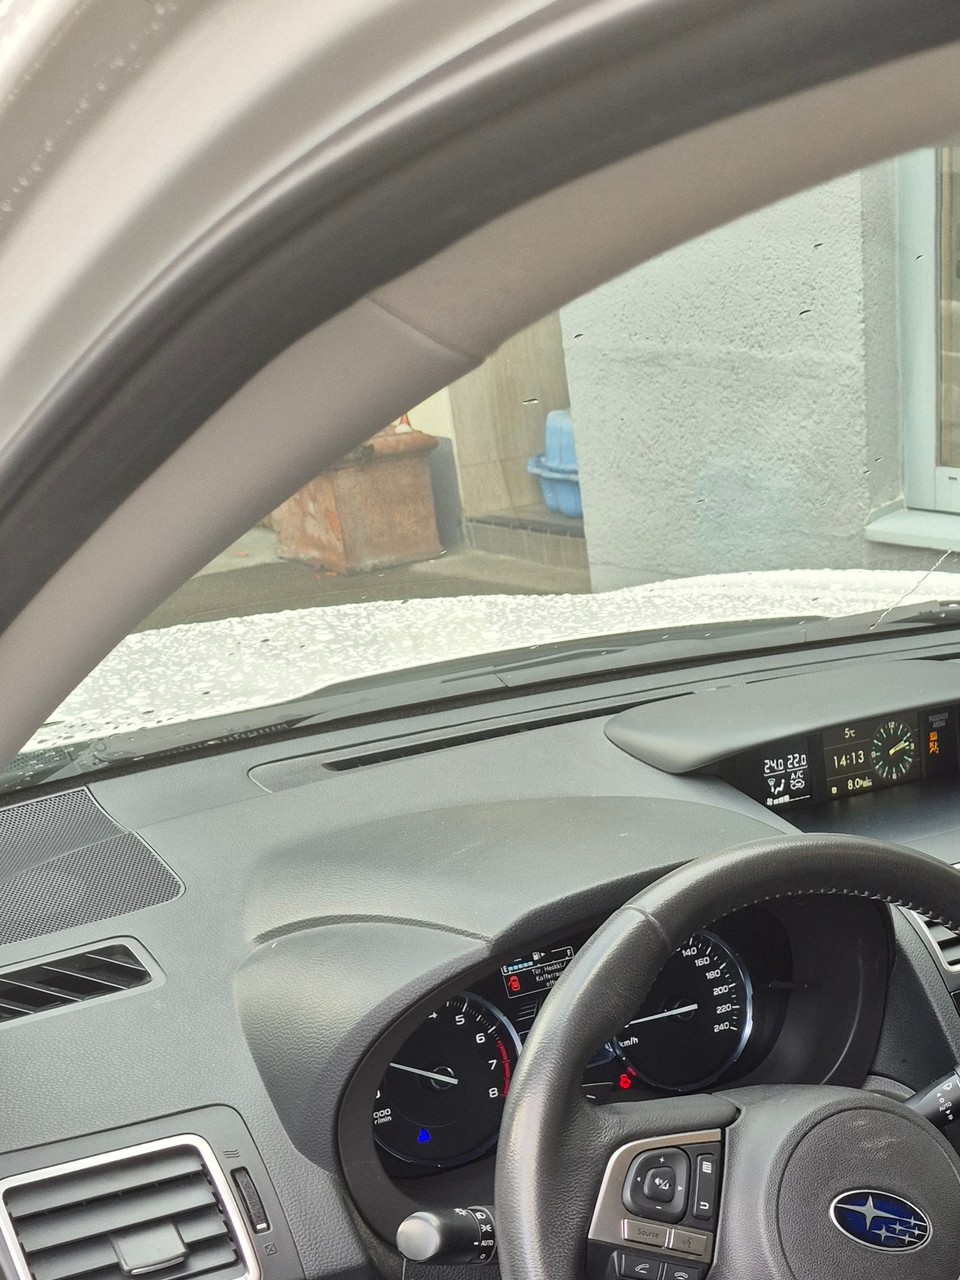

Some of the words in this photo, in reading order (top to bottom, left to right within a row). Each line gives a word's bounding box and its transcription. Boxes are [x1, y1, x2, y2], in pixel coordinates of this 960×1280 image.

[764, 759, 784, 773] 24.0
[786, 753, 807, 767] 22.0
[832, 751, 865, 770] 14:13
[790, 770, 804, 779] A/C
[847, 779, 860, 790] 8.0
[682, 946, 697, 957] 140
[695, 956, 710, 967] 160
[705, 969, 721, 980] 180
[713, 985, 729, 995] 200
[716, 1003, 732, 1014] 220
[455, 1014, 466, 1025] 5
[713, 1022, 730, 1032] 240
[475, 1033, 486, 1044] 6
[619, 1036, 639, 1047] km/h
[488, 1059, 498, 1070] 7
[488, 1087, 498, 1098] 8
[938, 1101, 952, 1111] AUTO
[638, 1228, 659, 1239] Source
